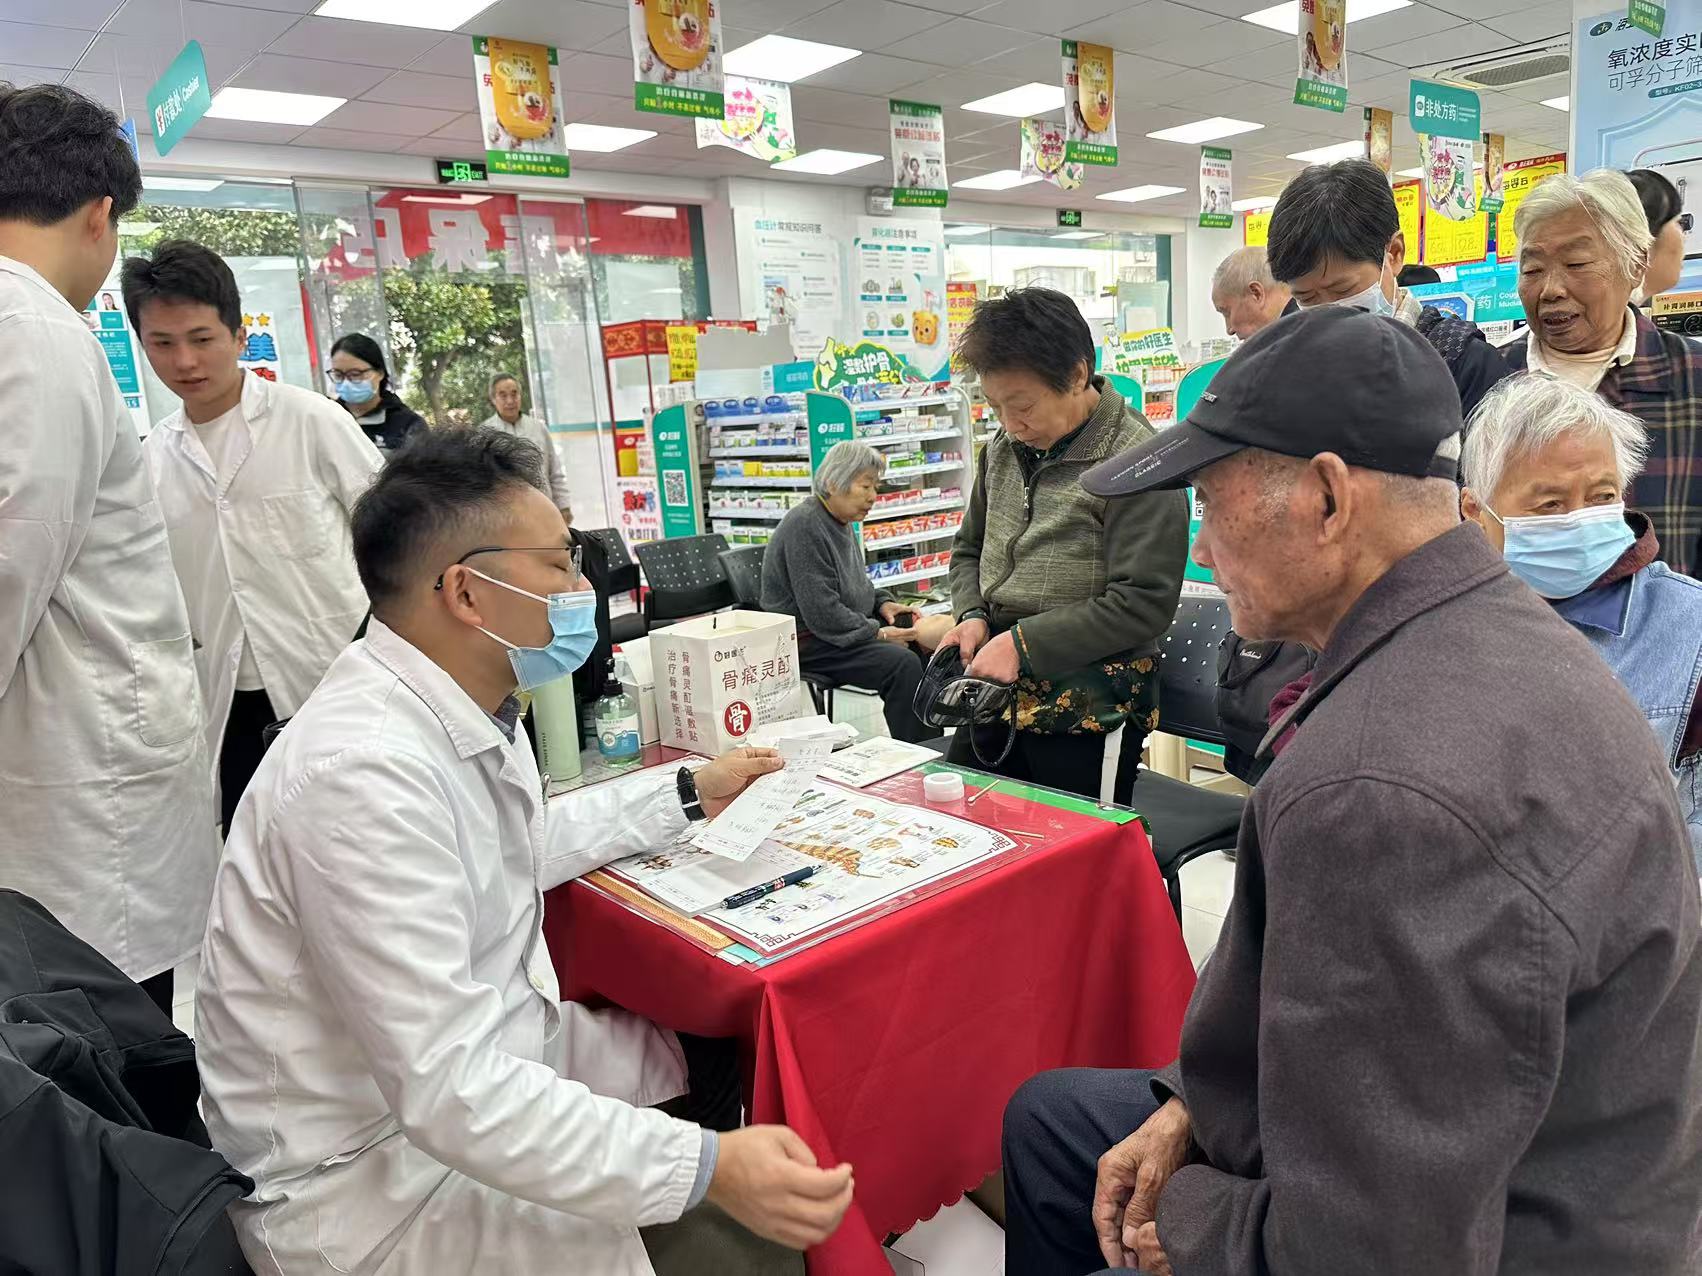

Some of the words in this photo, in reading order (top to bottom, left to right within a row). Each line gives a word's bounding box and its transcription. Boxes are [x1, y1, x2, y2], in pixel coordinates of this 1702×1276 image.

[1608, 33, 1702, 69] 氧浓度实
[1425, 99, 1457, 121] 非处方药
[1477, 294, 1492, 309] 药
[667, 649, 684, 740] 治疗骨痛新选择
[728, 703, 748, 733] 骨
